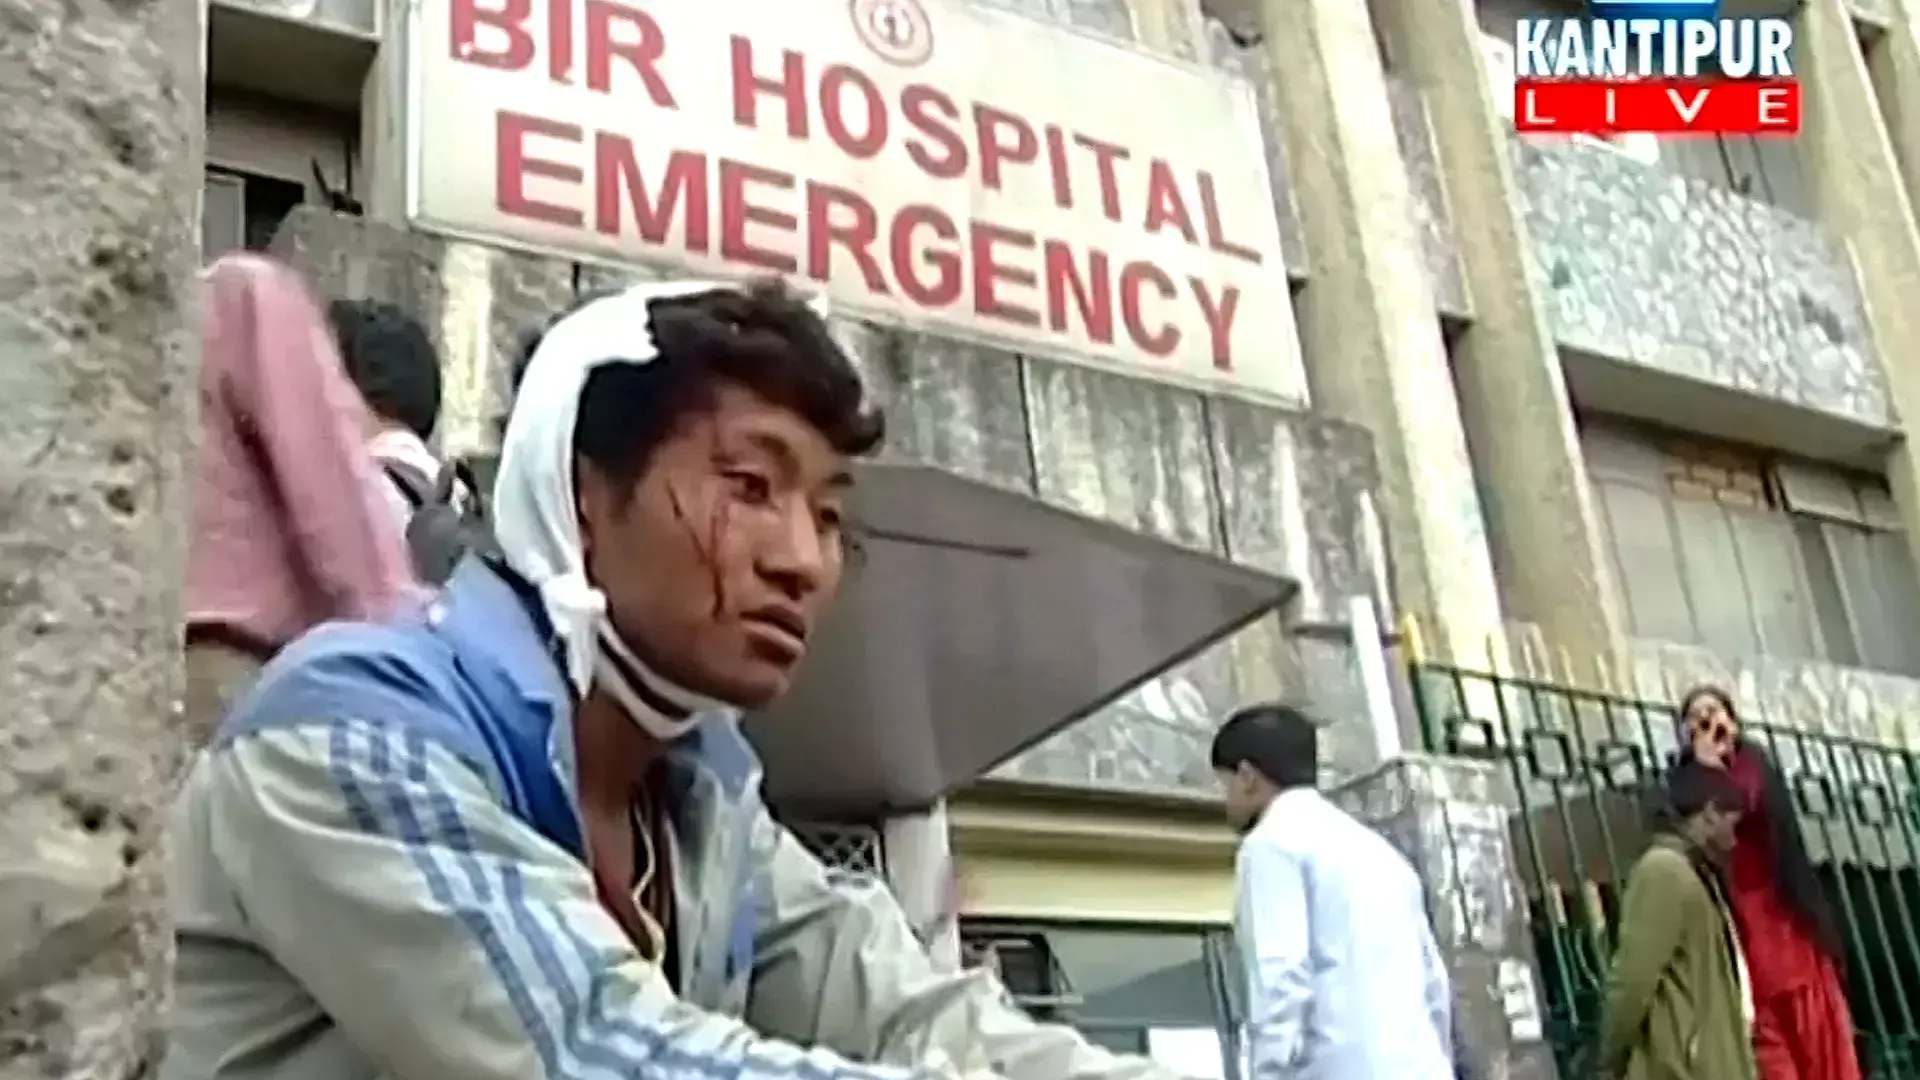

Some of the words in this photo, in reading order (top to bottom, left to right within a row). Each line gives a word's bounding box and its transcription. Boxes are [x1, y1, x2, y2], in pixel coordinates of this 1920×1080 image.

[449, 0, 678, 109] BIR
[730, 35, 1262, 264] HOSPITAL
[496, 111, 1240, 372] EMERGENCY
